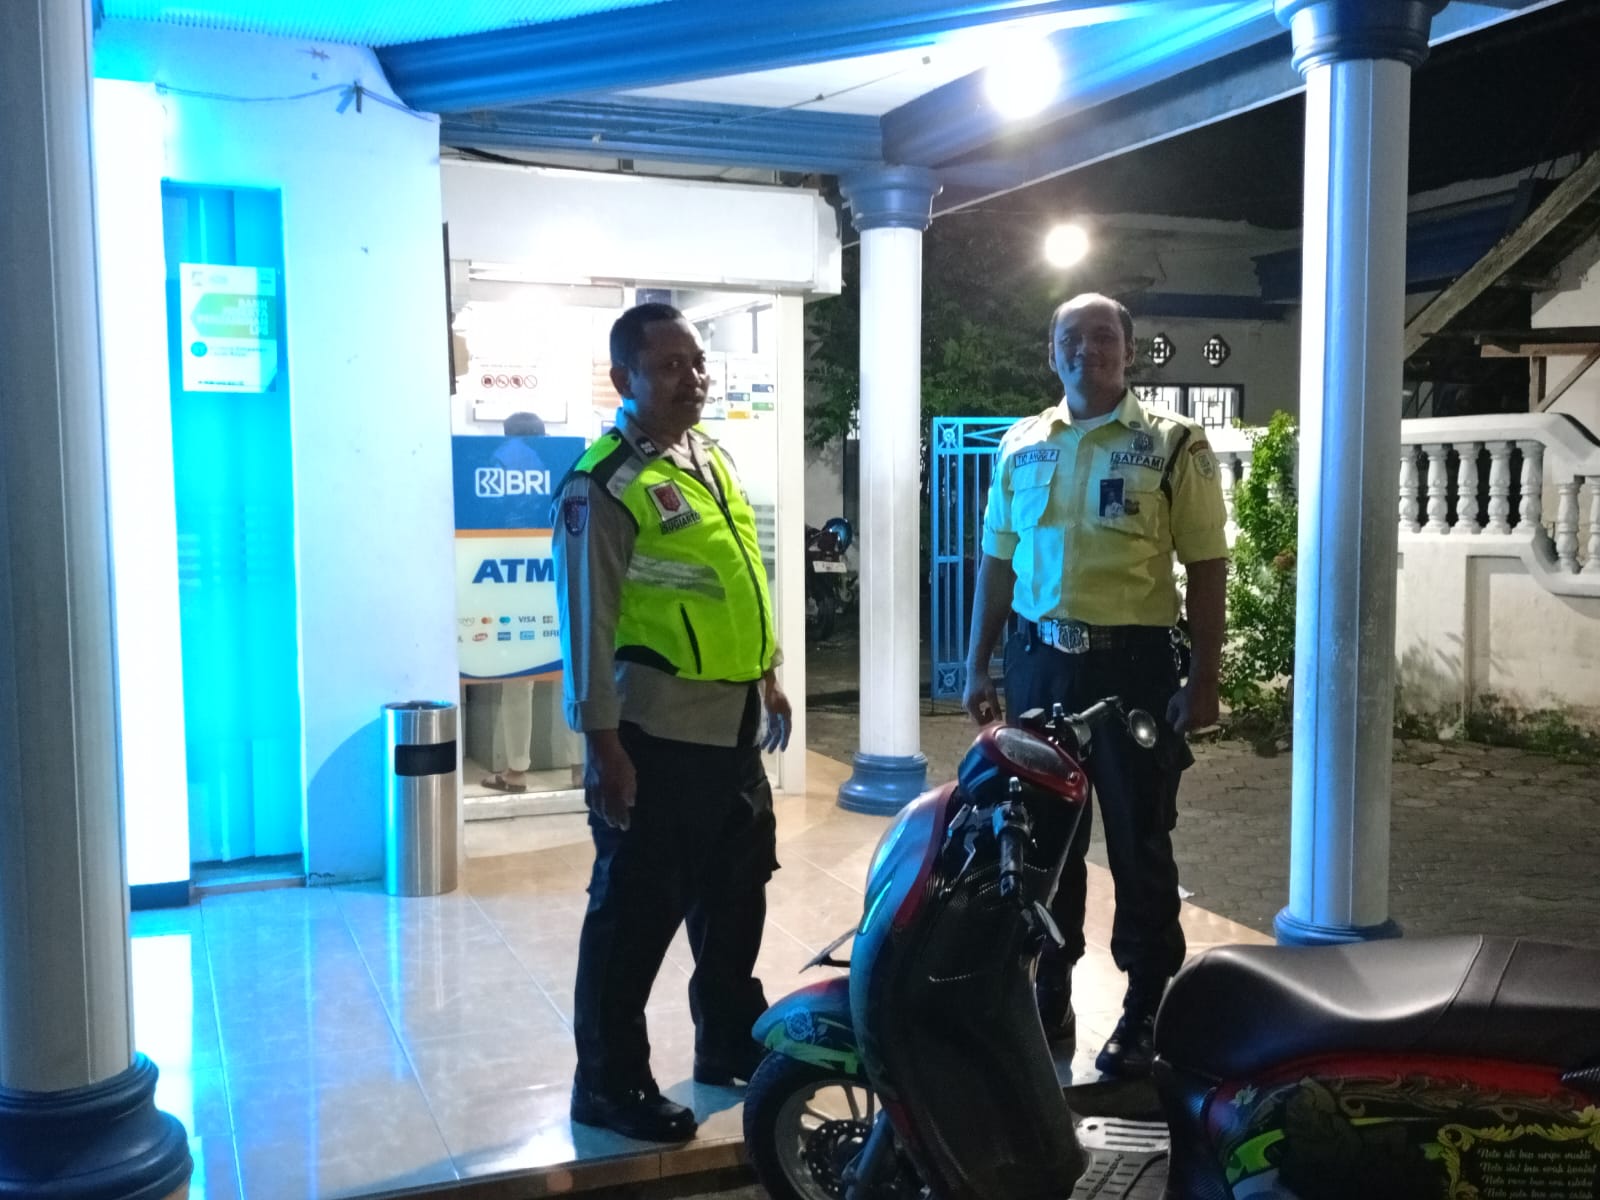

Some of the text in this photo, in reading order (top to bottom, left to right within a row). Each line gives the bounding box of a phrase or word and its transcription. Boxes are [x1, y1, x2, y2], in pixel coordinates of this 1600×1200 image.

[1113, 452, 1160, 469] SATPAM
[506, 469, 551, 495] BRI
[471, 558, 555, 584] ATM
[518, 615, 536, 623] VISA
